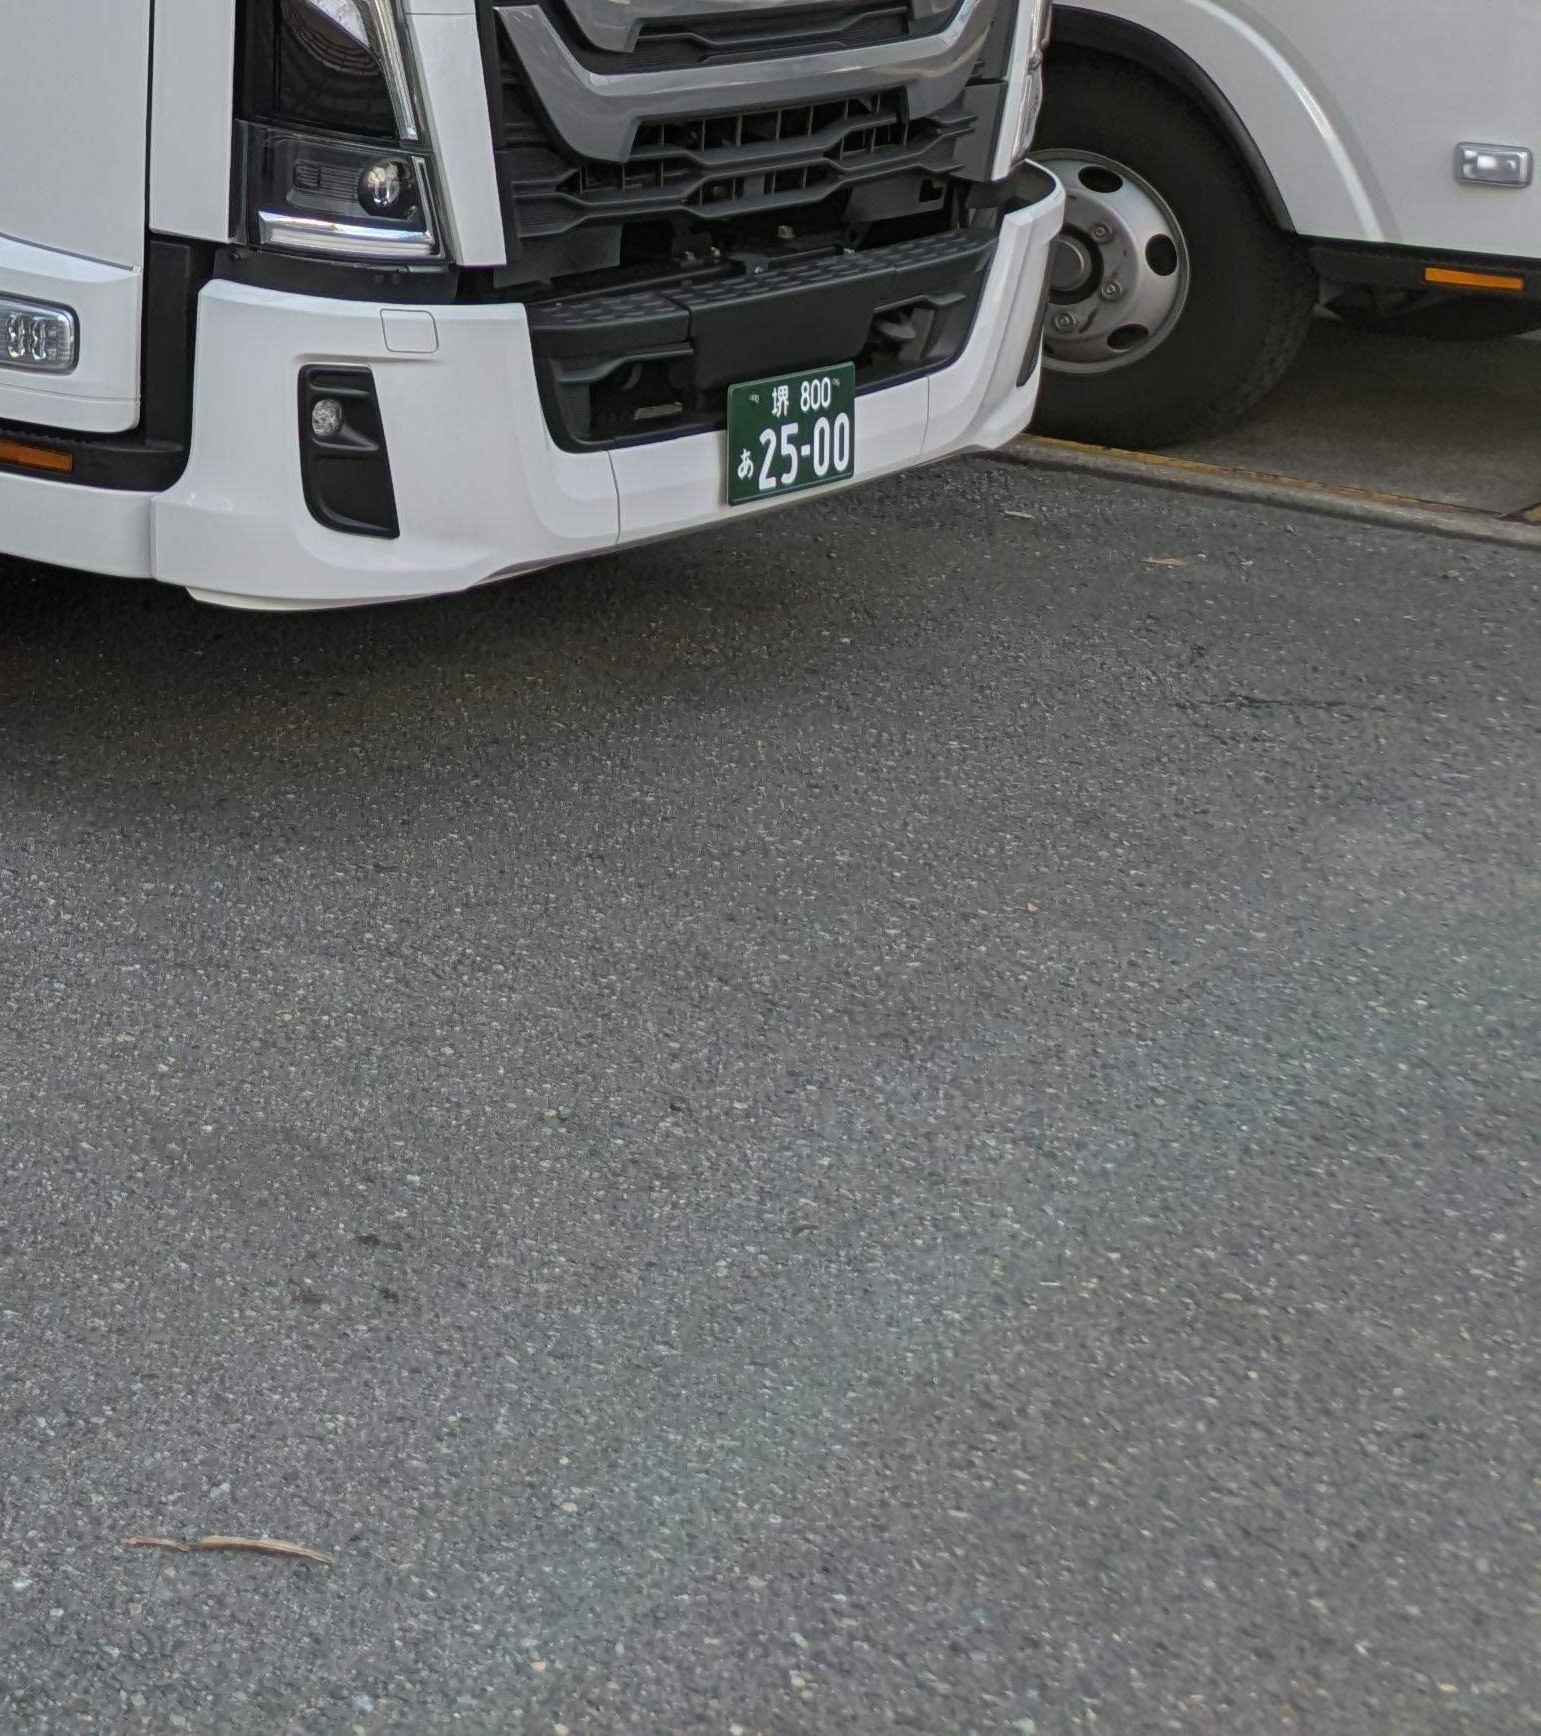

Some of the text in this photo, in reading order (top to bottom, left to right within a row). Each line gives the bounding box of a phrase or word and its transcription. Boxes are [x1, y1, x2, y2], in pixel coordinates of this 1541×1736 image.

[771, 376, 831, 418] 堺 800
[737, 412, 850, 491] あ 25-00
